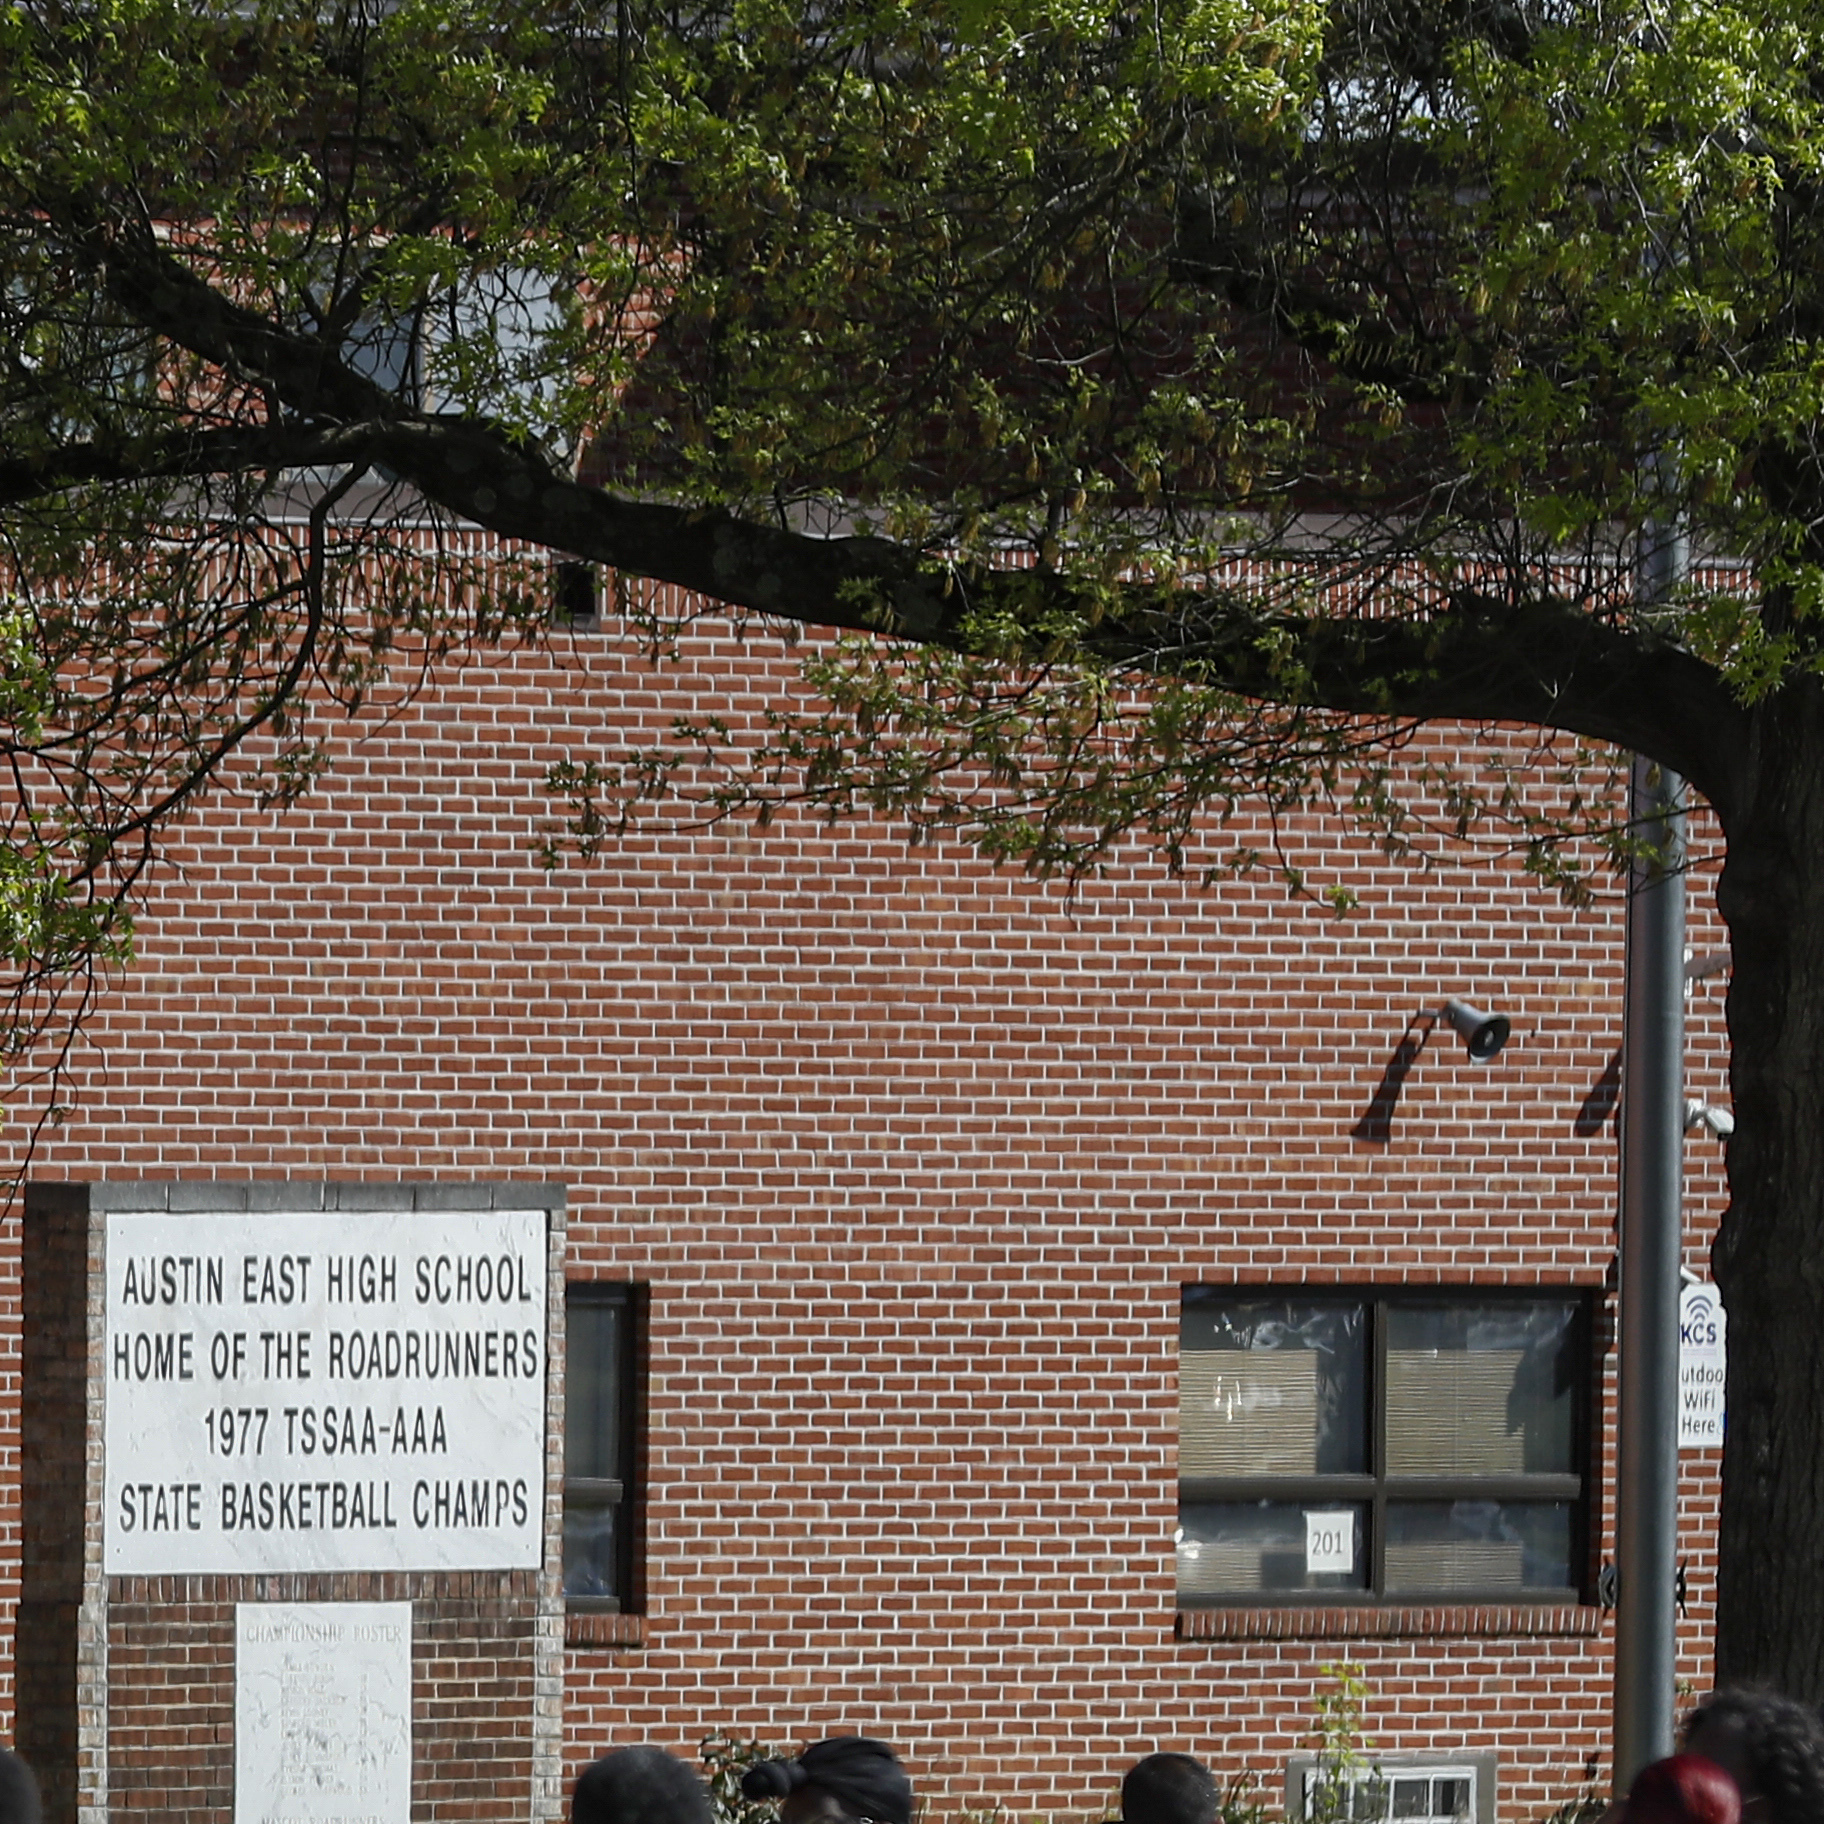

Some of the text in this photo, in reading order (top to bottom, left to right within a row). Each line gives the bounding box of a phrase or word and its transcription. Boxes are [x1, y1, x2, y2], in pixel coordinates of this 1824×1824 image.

[122, 1255, 531, 1304] AUSTIN EAST HIGH SCHOOL
[1681, 1321, 1717, 1345] KCS
[114, 1330, 538, 1381] HOME OF THE ROADRUNNERS
[1682, 1362, 1724, 1383] utdoo
[205, 1407, 447, 1456] 1977 TSSAA-AAA
[1682, 1416, 1716, 1434] Here
[120, 1479, 528, 1532] STATE BASKETBALL CHAMPS
[1312, 1529, 1342, 1555] 201
[246, 1624, 344, 1642] CHAMPIONSHIP
